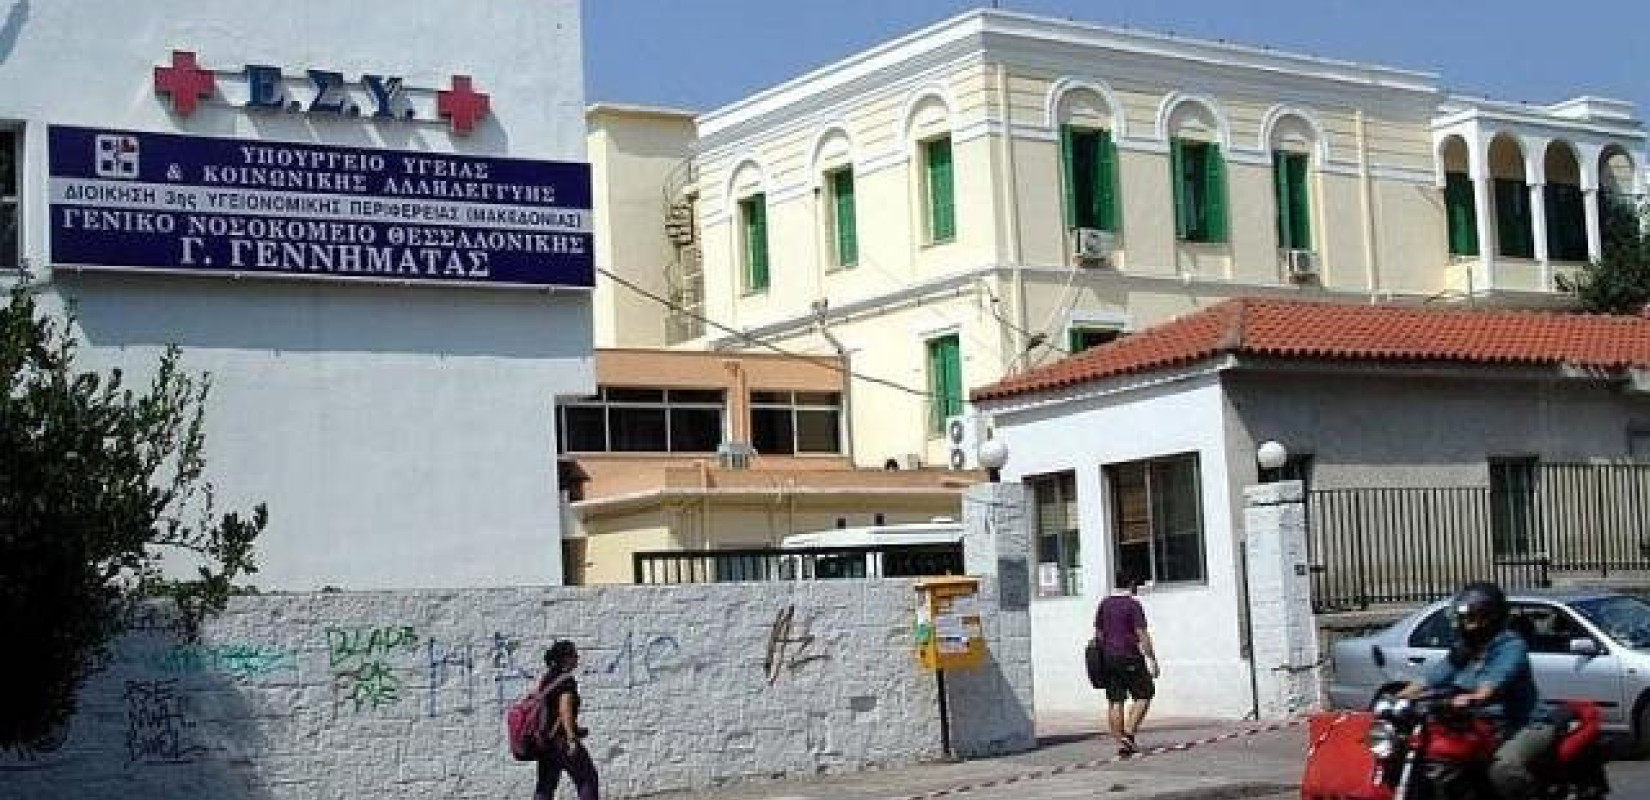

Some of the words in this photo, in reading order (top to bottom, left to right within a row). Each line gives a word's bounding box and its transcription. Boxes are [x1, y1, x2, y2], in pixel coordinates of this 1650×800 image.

[242, 147, 385, 170] ΥΠΟΥΡΓΕΙΟ
[404, 158, 488, 178] ΥΓΕΙΑΣ
[167, 164, 182, 180] &
[204, 166, 366, 190] ΚΟΙΝΩΝΙΚΗΣ
[384, 179, 555, 202] ΑΛΛΗΛΕΓΓΥΗΣ
[65, 185, 156, 203] ΔΙΟΙΚΗΣΗ
[164, 192, 197, 209] 3ης
[208, 194, 340, 212] ΥΓΕΙΟΝΟΜΙΚΗΣ
[350, 201, 457, 219] ΠΕΡΙΦΕΡΕΙΑΣ
[466, 209, 581, 228] (ΜΑΚΕΔΟΝΙΑΣ)
[63, 208, 175, 232] ΓΕΝΙΚΟ
[187, 216, 376, 243] ΝΟΣΟΚΟΜΕΙΟ
[387, 225, 583, 253] ΘΕΣΣΑΛΟΝΙΚΗΣ
[179, 237, 212, 264] Γ.
[230, 240, 490, 277] ΓΕΝΝΗΜΑΤΑΣ
